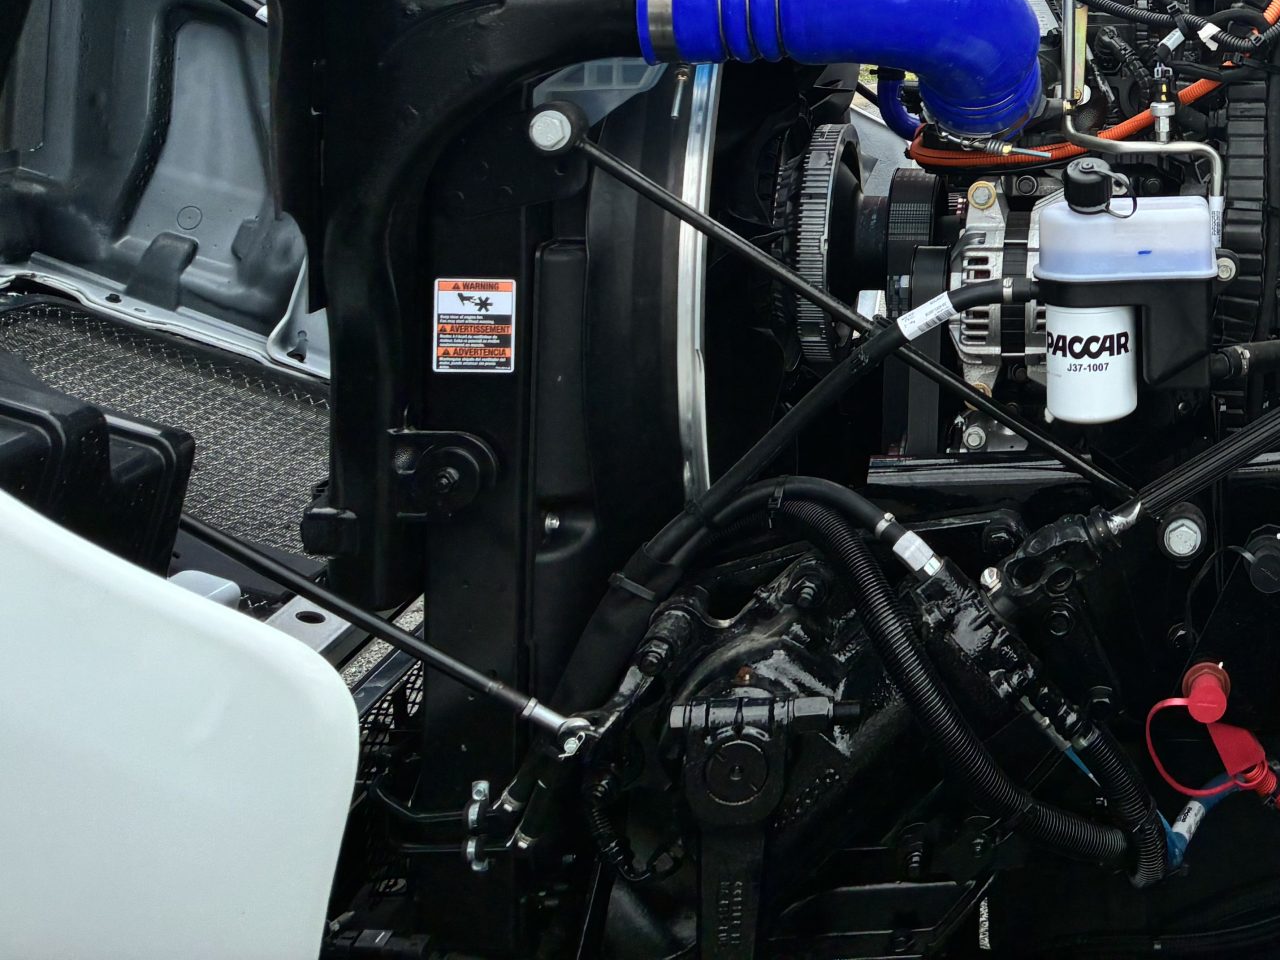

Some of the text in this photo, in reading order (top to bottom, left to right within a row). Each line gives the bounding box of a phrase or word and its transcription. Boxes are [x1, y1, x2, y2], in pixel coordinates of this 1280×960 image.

[463, 282, 500, 290] WARNING
[1047, 330, 1130, 360] PACCAR
[453, 348, 506, 356] ADVERTENCIA
[1067, 362, 1110, 372] J37-1007
